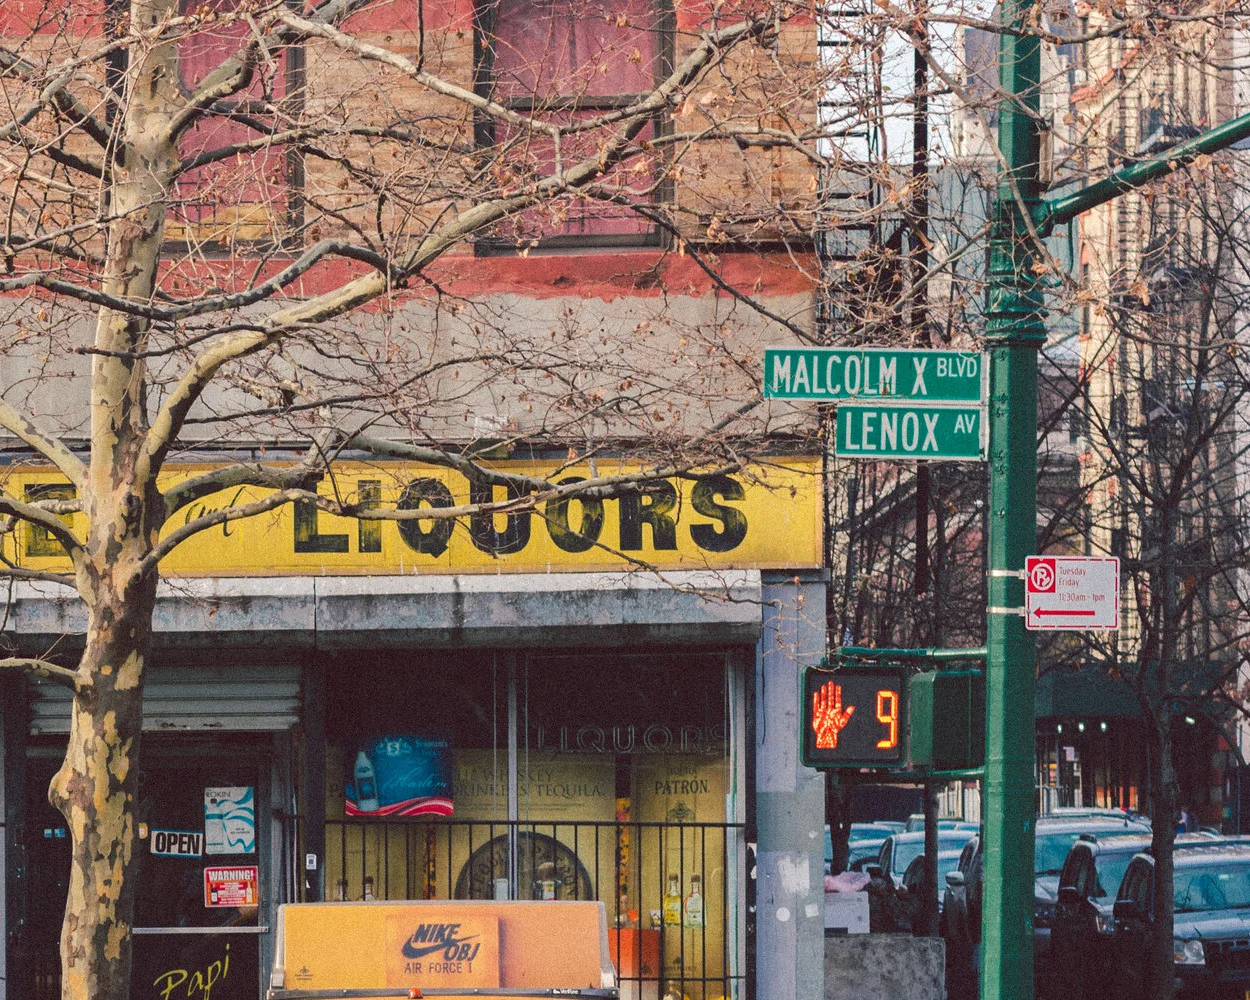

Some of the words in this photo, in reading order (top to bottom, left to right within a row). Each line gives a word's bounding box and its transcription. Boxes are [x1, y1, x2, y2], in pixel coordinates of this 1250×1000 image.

[773, 355, 897, 395] MALCOLM
[911, 357, 928, 396] X
[937, 358, 977, 378] BLVD
[845, 411, 939, 452] LENOX
[953, 414, 976, 434] AV
[293, 475, 749, 558] LIQUORS
[1058, 578, 1080, 587] Friday
[1059, 567, 1087, 577] Tuesday
[876, 690, 899, 750] 9
[155, 831, 200, 855] OPEN
[208, 869, 254, 881] WARNING!
[411, 923, 462, 944] NIKE
[444, 942, 481, 962] OBJ
[404, 962, 423, 974] AIR
[429, 962, 463, 974] FORCE
